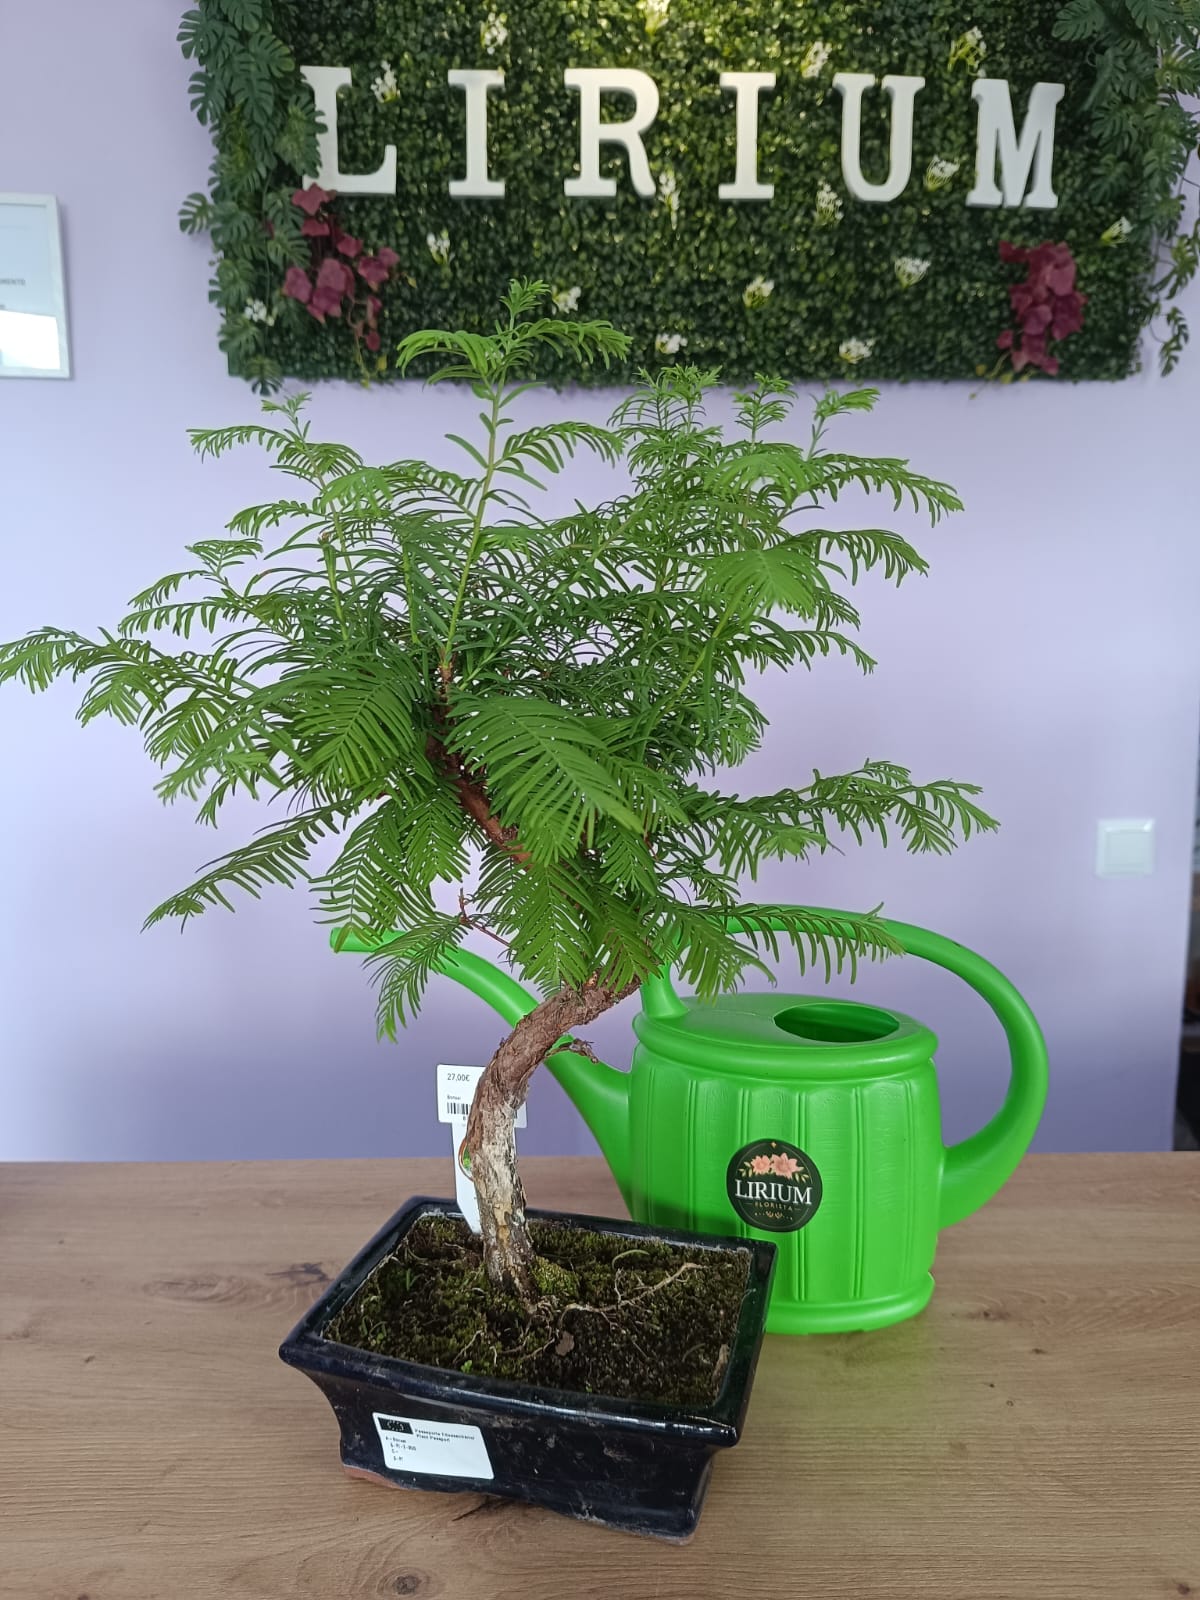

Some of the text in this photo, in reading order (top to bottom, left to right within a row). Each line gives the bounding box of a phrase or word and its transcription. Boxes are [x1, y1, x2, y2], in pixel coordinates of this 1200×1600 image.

[300, 65, 1065, 208] LIRIUM
[447, 1073, 471, 1082] 27,00€
[735, 1179, 813, 1205] LIRIUM
